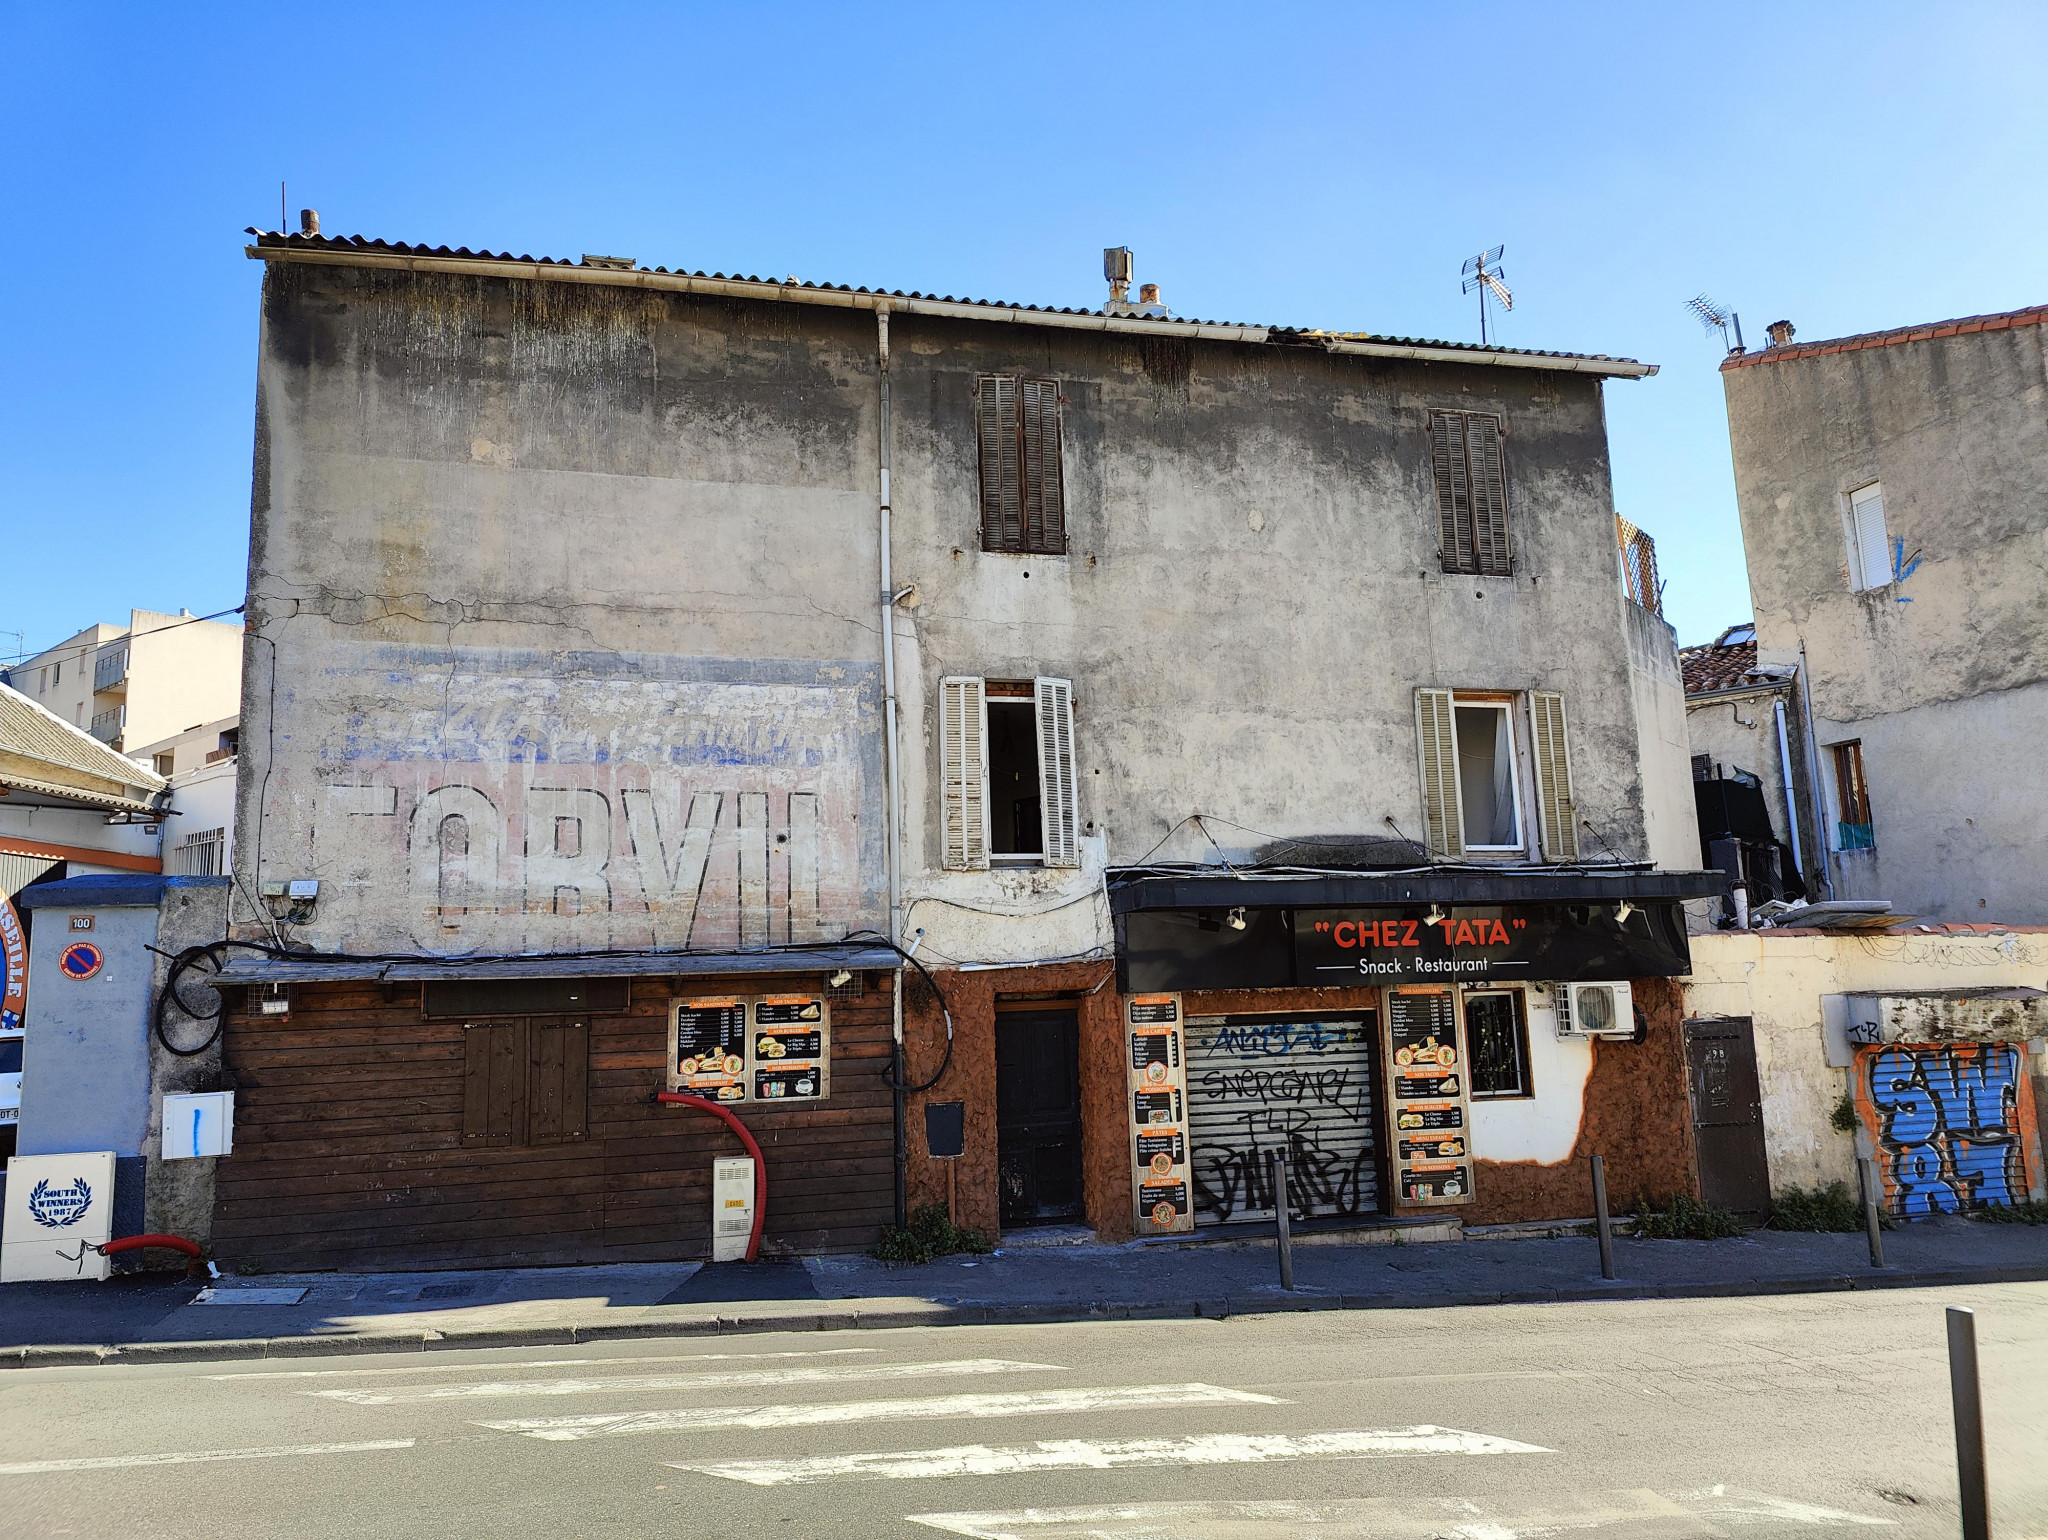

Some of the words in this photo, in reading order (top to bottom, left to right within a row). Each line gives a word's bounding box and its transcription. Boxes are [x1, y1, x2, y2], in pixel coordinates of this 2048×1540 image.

[73, 918, 90, 929] 100
[1359, 957, 1403, 975] Snack
[1415, 956, 1489, 973] Restaurant
[1712, 1049, 1725, 1059] 98
[43, 1188, 78, 1198] SOUTH
[37, 1198, 83, 1208] WINNERS
[48, 1208, 72, 1217] 1987
